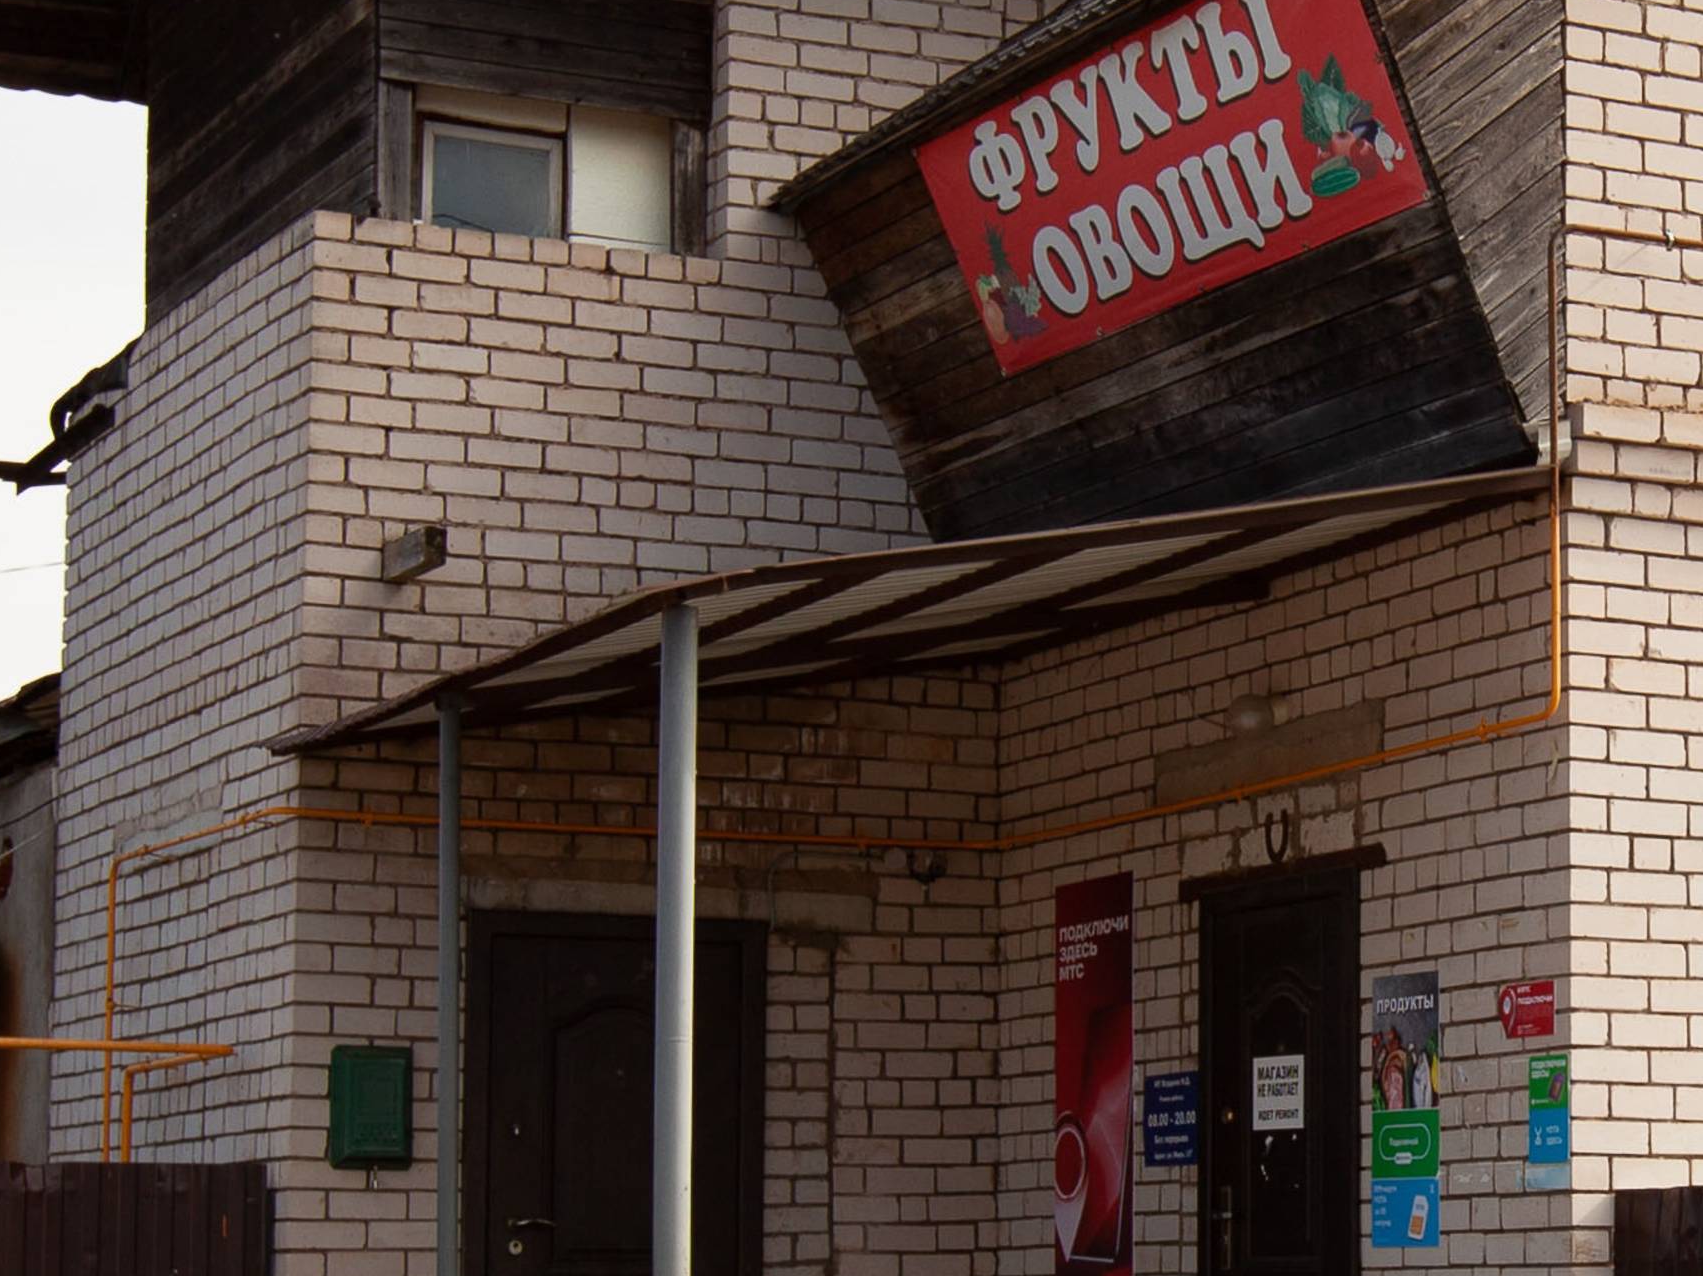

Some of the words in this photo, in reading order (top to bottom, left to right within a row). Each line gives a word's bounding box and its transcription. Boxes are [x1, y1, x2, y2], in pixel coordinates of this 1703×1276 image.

[1032, 119, 1313, 314] ОВОЩИ
[1059, 915, 1129, 942] ПОДКЛЮЧИ
[1059, 942, 1097, 963] ЗДЕСЬ
[1059, 963, 1085, 981] МТС
[1377, 994, 1434, 1013] ПРОДУКТЫ
[1258, 1065, 1299, 1080] МАГАЗИН
[1257, 1083, 1266, 1097] НЕ
[1267, 1081, 1299, 1096] РАБОТАЕТ
